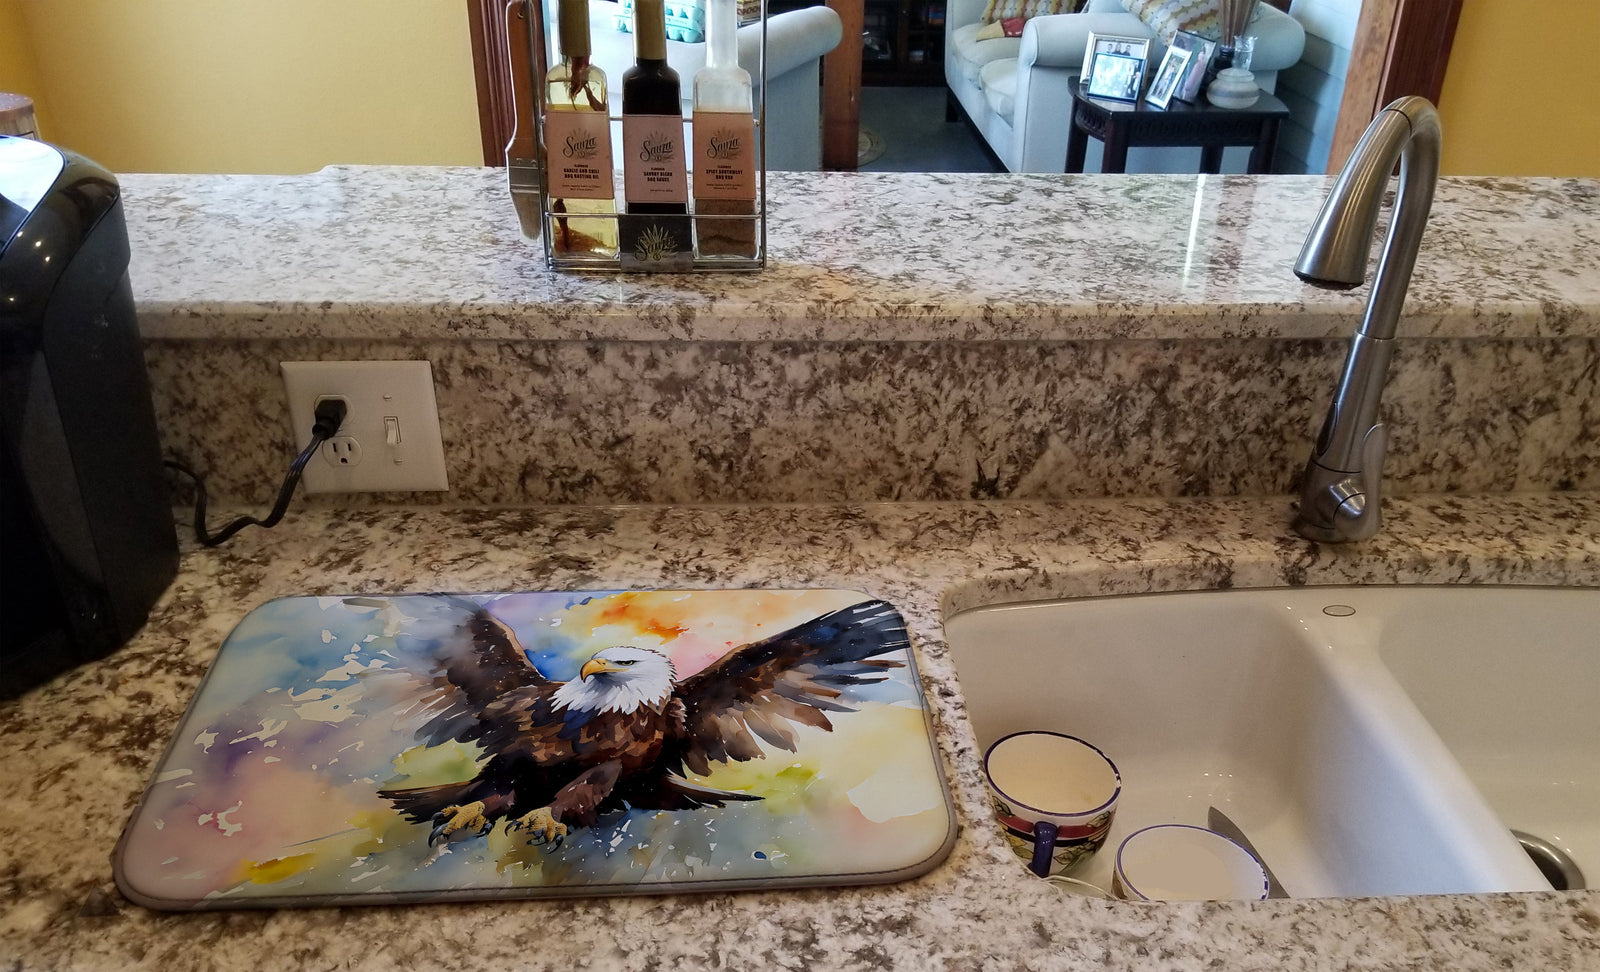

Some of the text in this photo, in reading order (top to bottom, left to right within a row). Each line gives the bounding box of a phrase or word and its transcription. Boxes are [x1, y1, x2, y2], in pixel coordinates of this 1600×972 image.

[563, 136, 597, 158] Sauza
[640, 140, 674, 162] Sauza
[707, 136, 740, 159] Sauza
